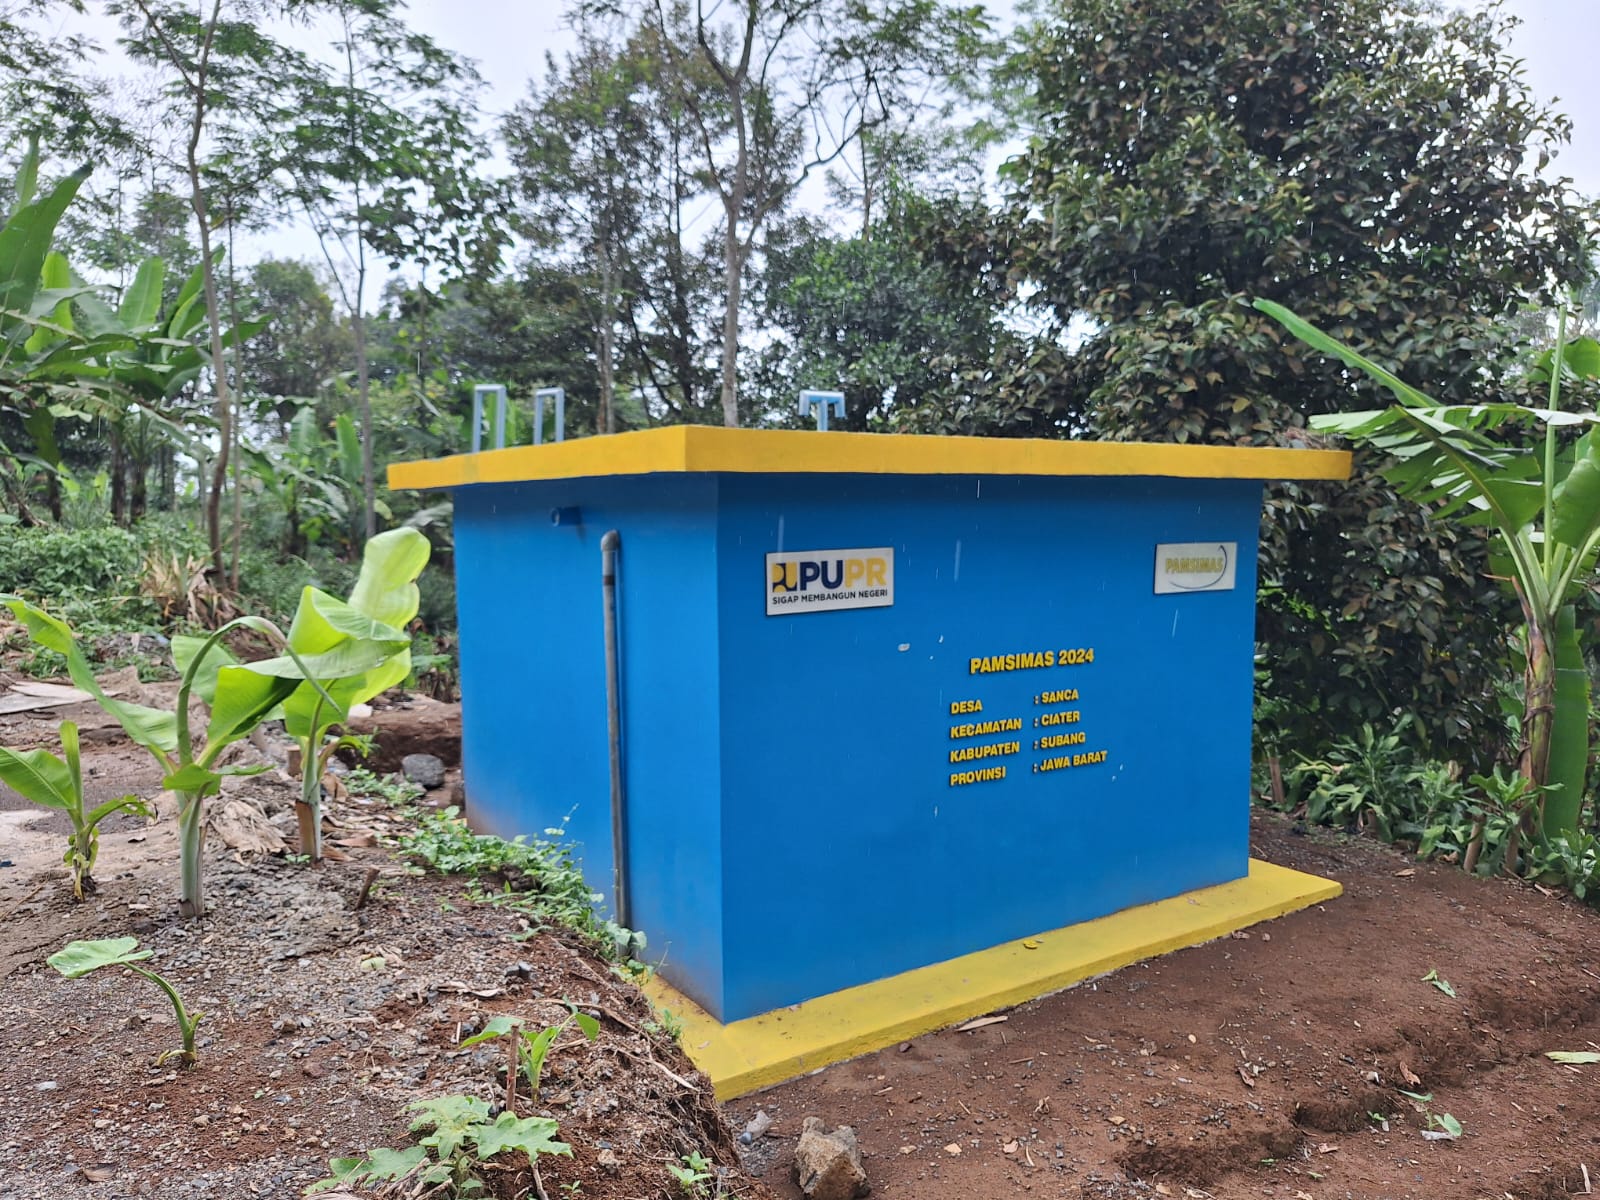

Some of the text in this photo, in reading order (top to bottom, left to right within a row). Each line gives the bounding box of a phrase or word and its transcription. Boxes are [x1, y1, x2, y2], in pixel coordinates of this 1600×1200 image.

[799, 557, 887, 591] PUPR
[1165, 557, 1224, 574] PAMSIMAS
[772, 589, 888, 605] SIGAP MEMBANGUN NEGERI
[970, 648, 1095, 674] PAMSIMAS 2024
[951, 700, 983, 714] DESA
[1041, 689, 1079, 703] SANCA
[950, 718, 1022, 738] KECAMATAN
[1041, 711, 1081, 726] CIATER
[950, 741, 1020, 762] KABUPATEN
[1040, 732, 1086, 748] SUBANG
[950, 766, 1007, 786] PROVINSI
[1039, 756, 1071, 771] JAWA
[1073, 750, 1108, 766] BARAT
